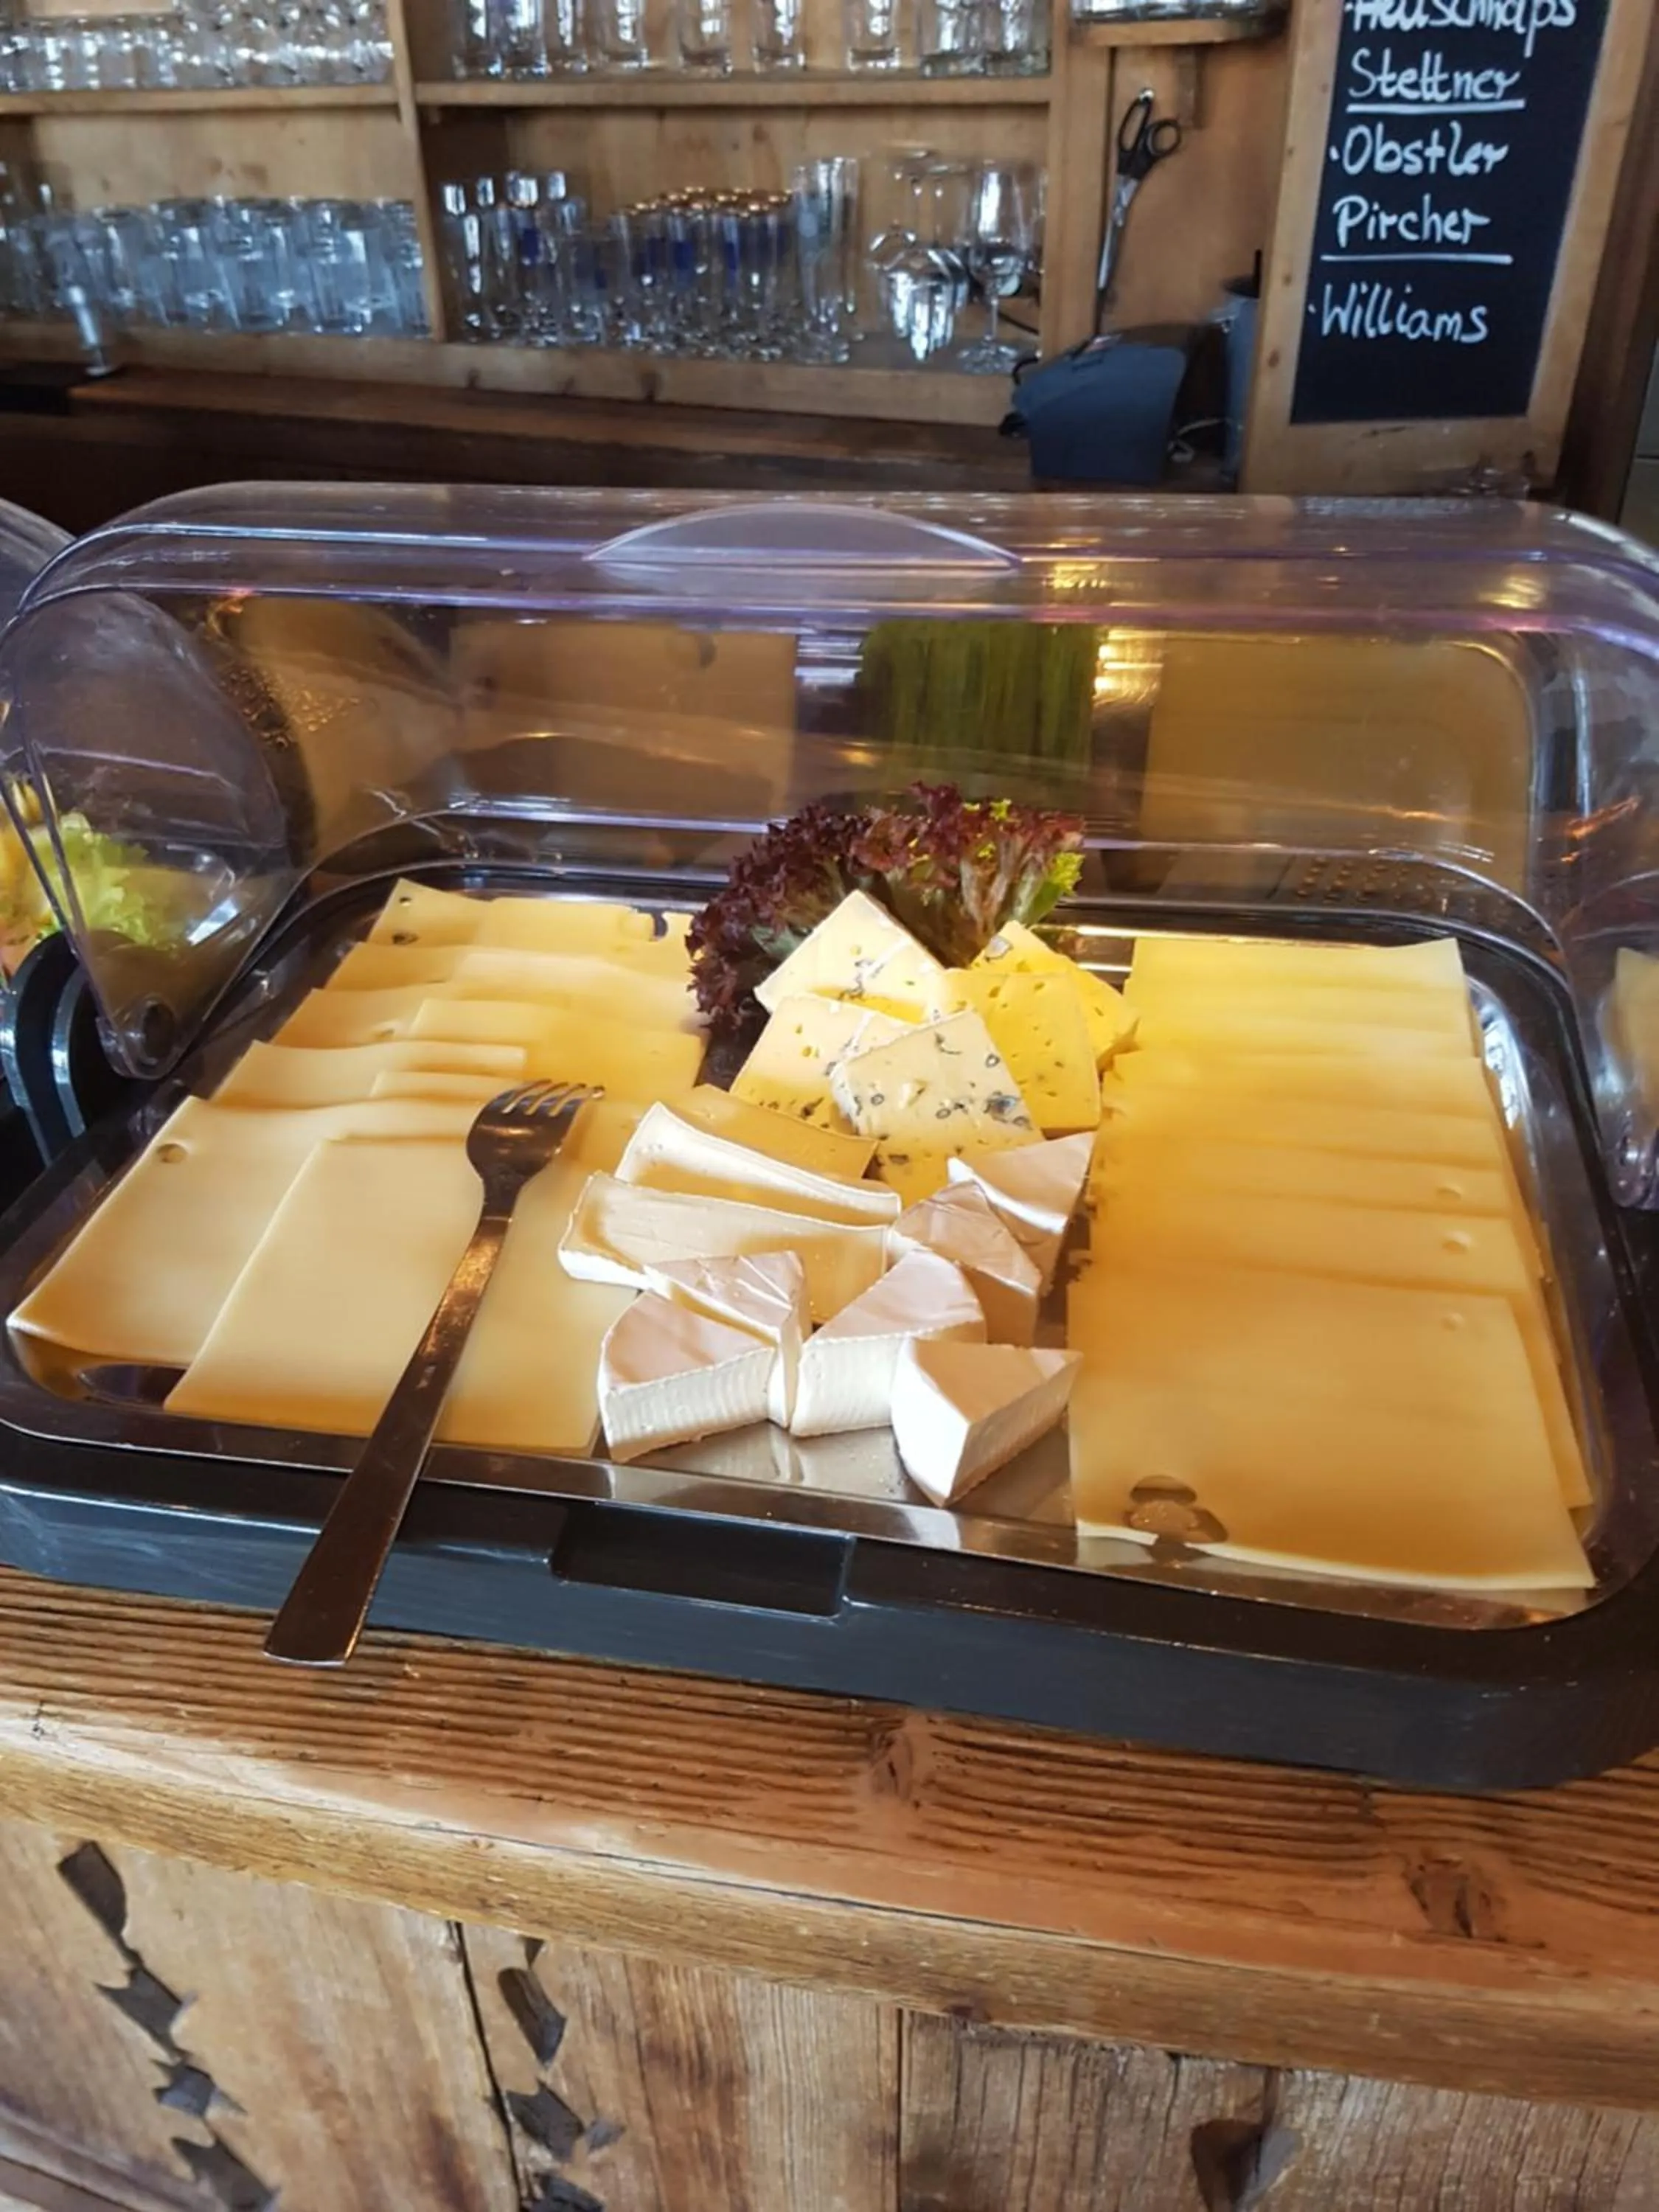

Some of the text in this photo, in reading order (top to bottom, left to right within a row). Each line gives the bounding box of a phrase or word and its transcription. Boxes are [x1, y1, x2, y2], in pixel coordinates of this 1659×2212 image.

[1348, 48, 1520, 102] Stettner
[1332, 194, 1490, 247] Pircher
[1322, 282, 1488, 343] Williams
